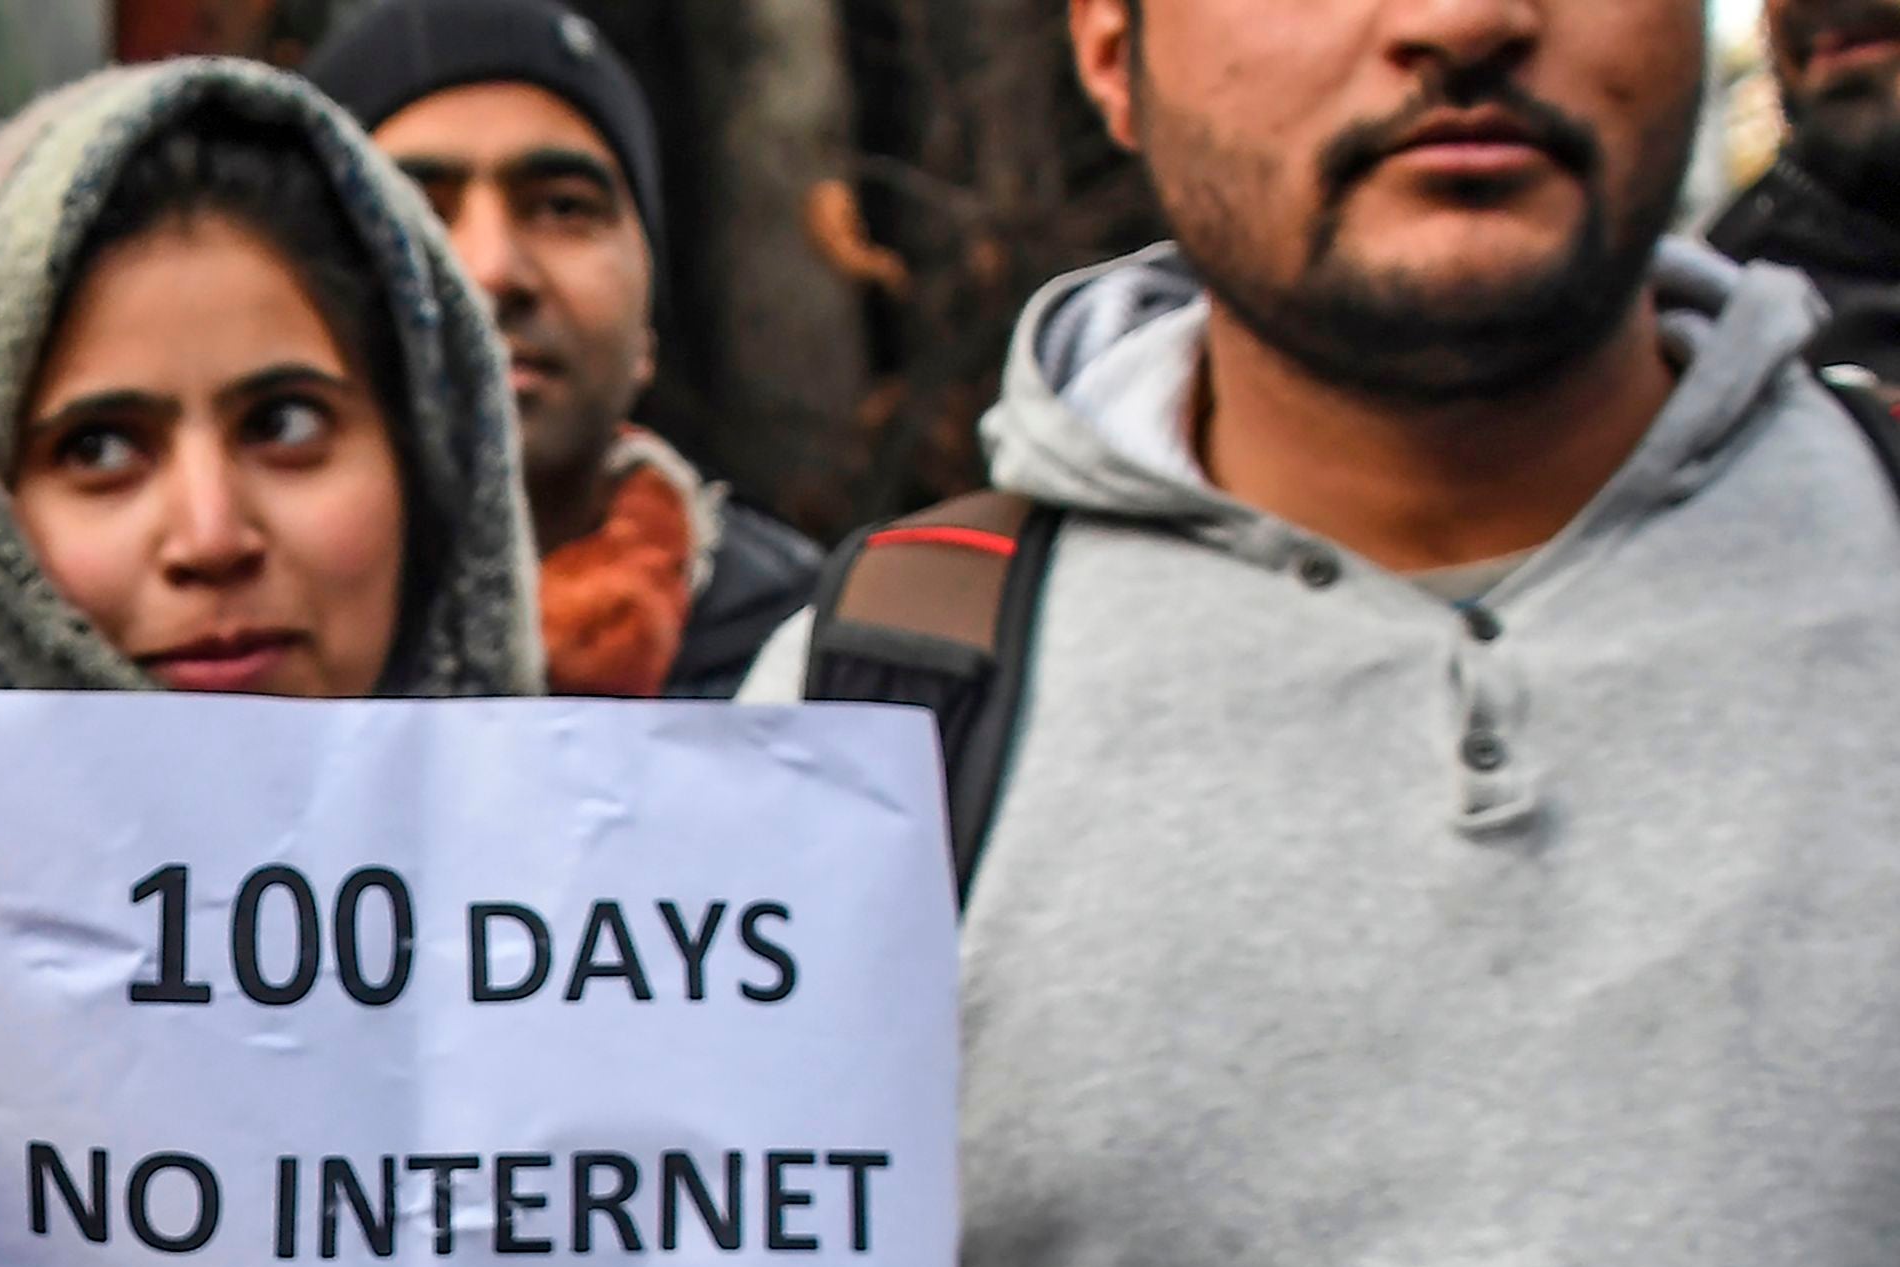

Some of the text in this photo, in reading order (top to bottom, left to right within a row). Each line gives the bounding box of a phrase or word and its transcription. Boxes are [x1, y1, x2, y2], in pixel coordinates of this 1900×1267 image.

[128, 865, 796, 1007] 100 DAYS
[28, 1142, 889, 1259] NO INTERNET
